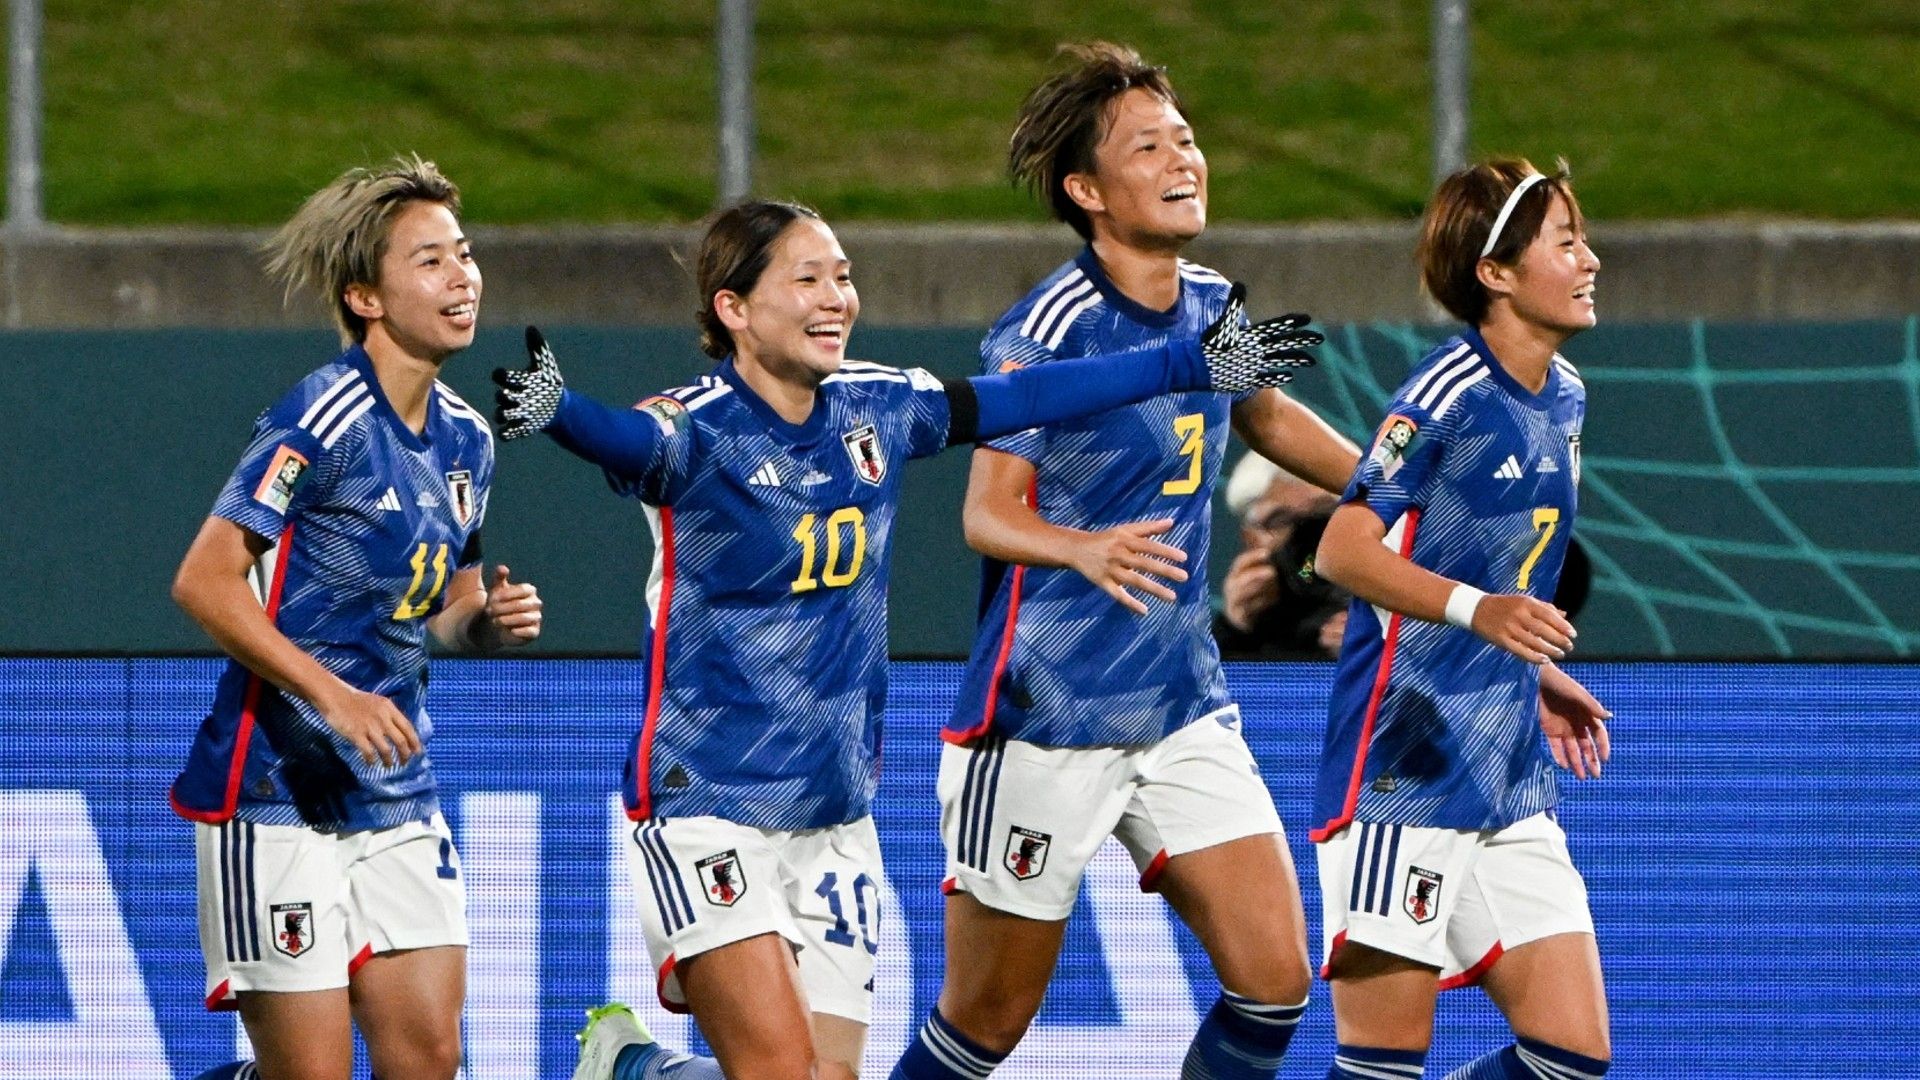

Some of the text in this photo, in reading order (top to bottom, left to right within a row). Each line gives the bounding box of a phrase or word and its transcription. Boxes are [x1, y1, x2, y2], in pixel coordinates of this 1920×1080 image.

[1162, 413, 1205, 496] 3
[393, 543, 449, 621] 11
[791, 507, 866, 593] 10
[1516, 508, 1560, 590] 7
[815, 872, 881, 956] 10
